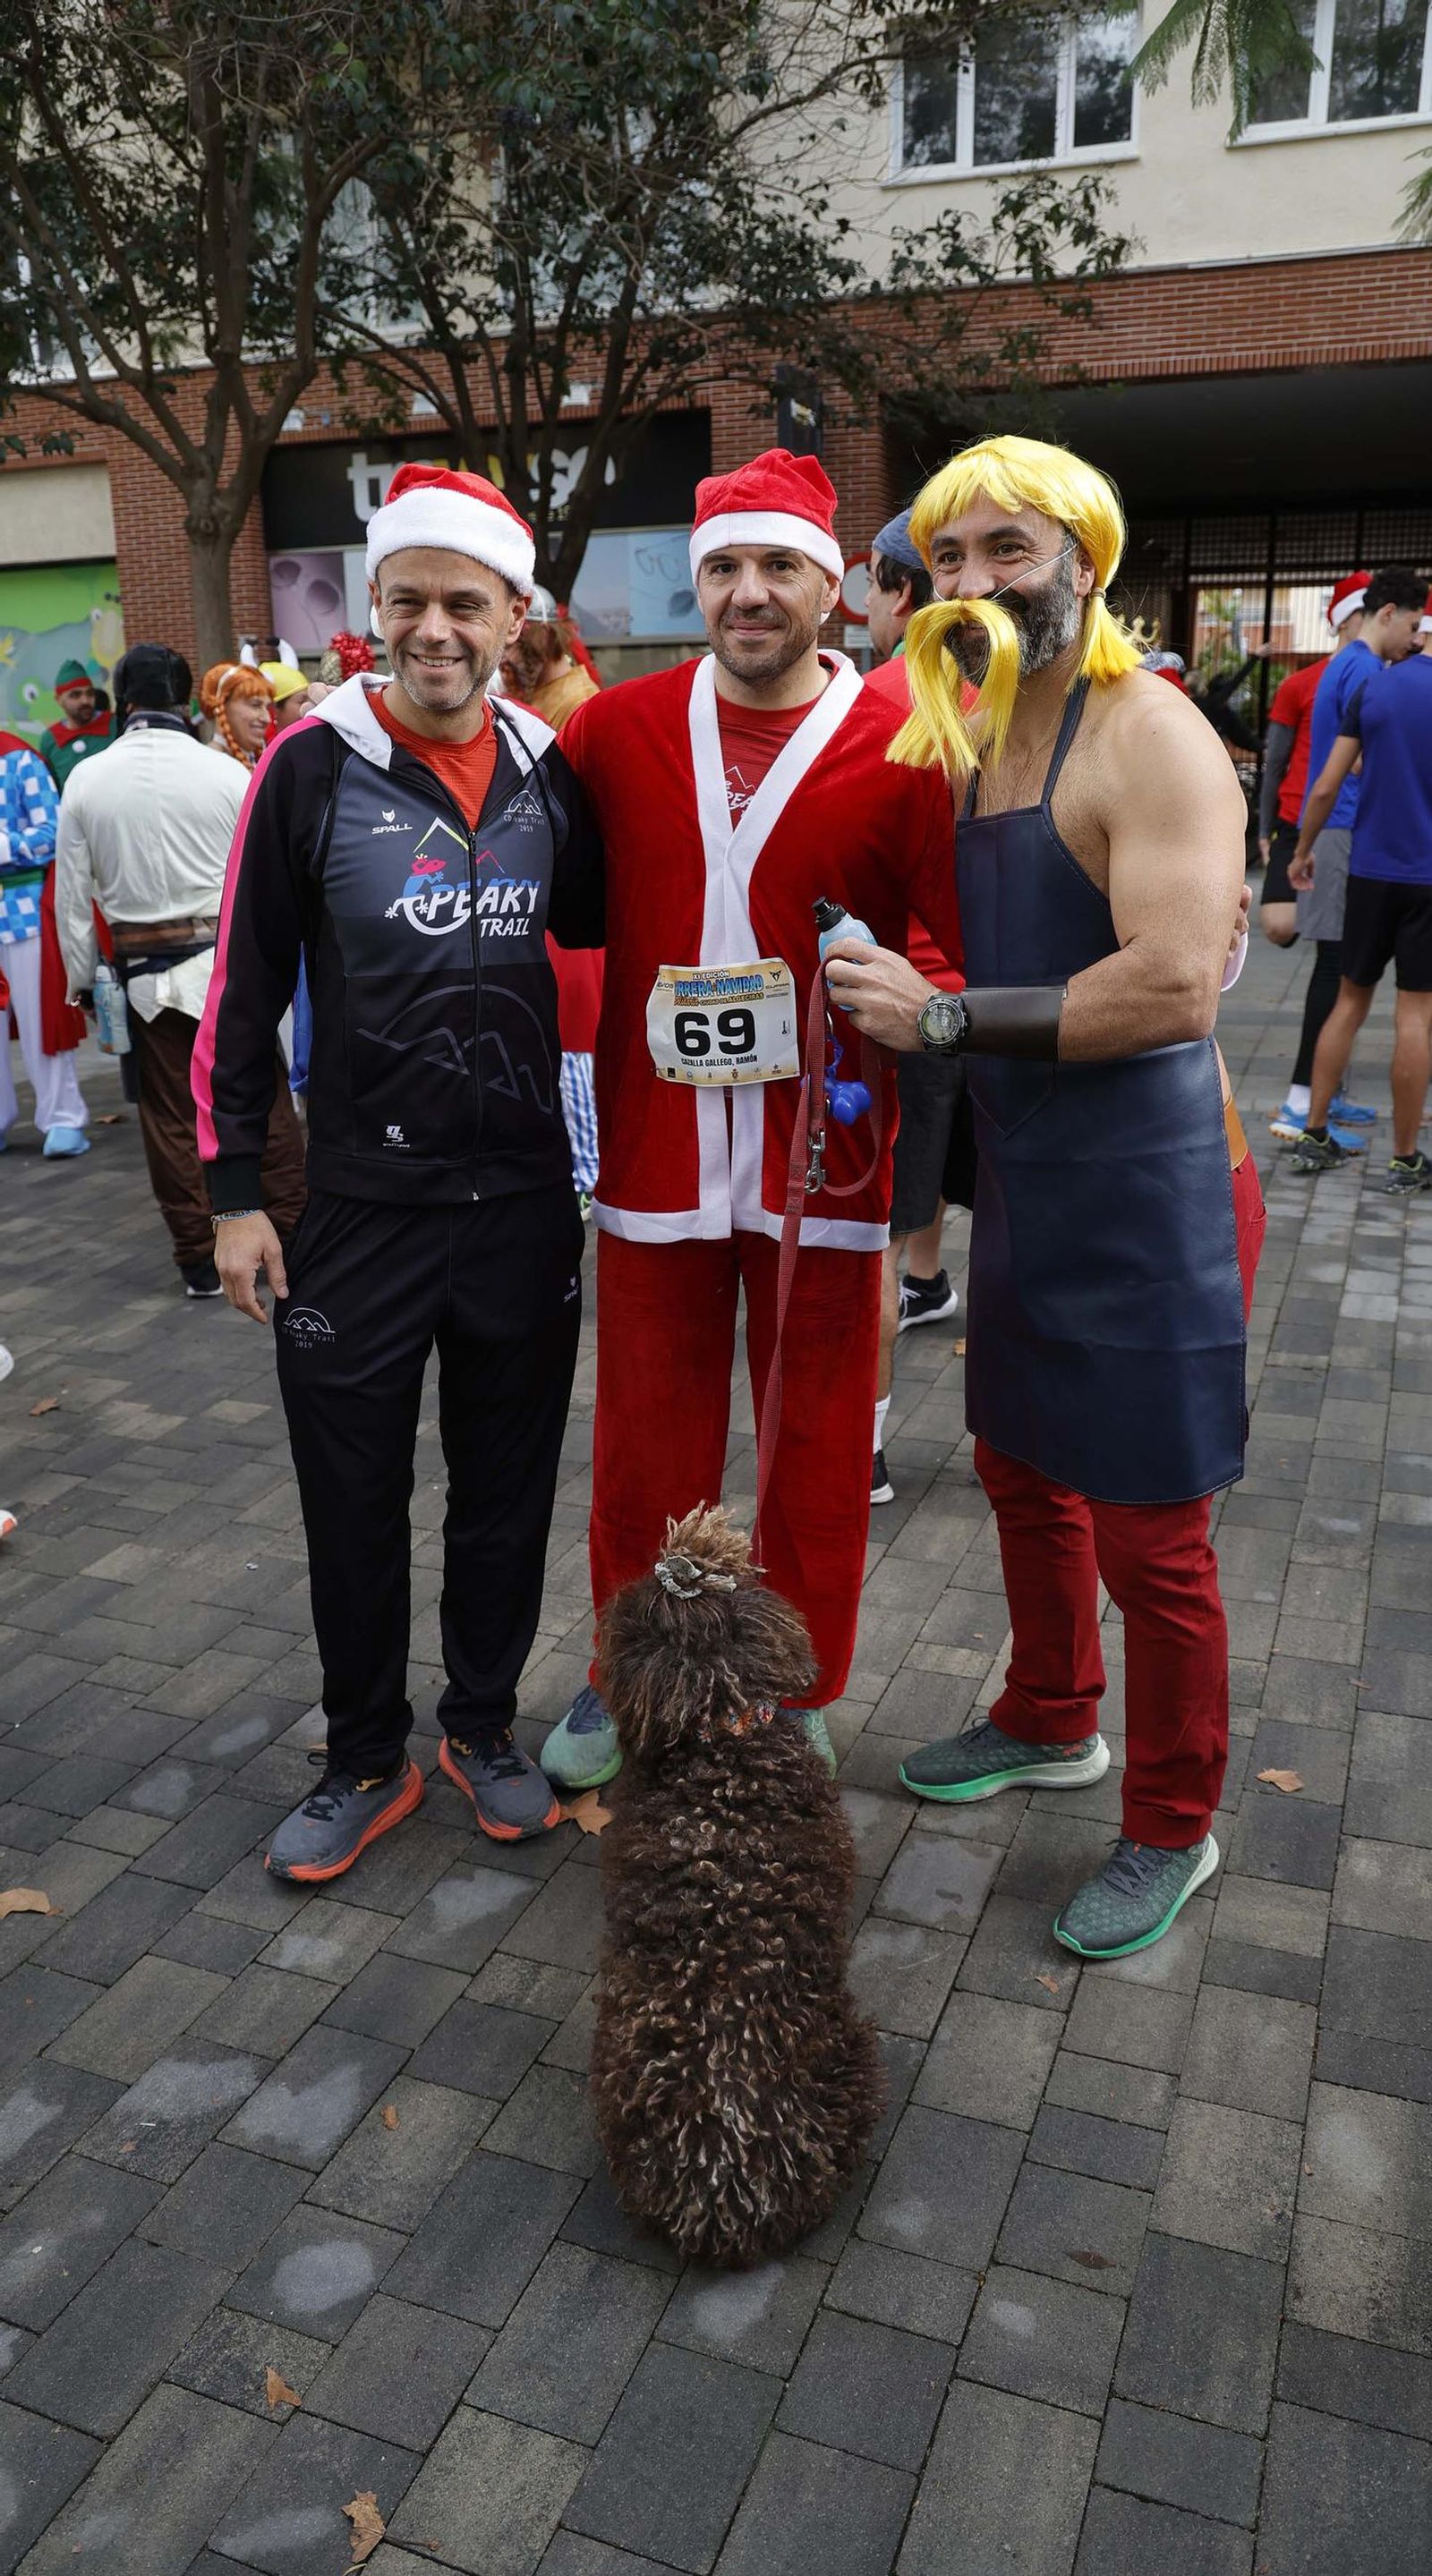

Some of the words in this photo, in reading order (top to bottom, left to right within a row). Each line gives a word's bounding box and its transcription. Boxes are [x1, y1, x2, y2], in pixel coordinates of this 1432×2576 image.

[371, 823, 413, 835] SPALL
[426, 878, 541, 922] PEAKY
[481, 917, 530, 939] TRAIL
[702, 970, 729, 980] EDICIÓN
[715, 974, 763, 995] NAVIDAD
[729, 992, 764, 1003] ALGECIRAS
[675, 1008, 755, 1057] 69
[681, 1058, 703, 1067] CAZALLA
[705, 1058, 735, 1067] GALLEGO,
[736, 1055, 758, 1066] RAMÓN
